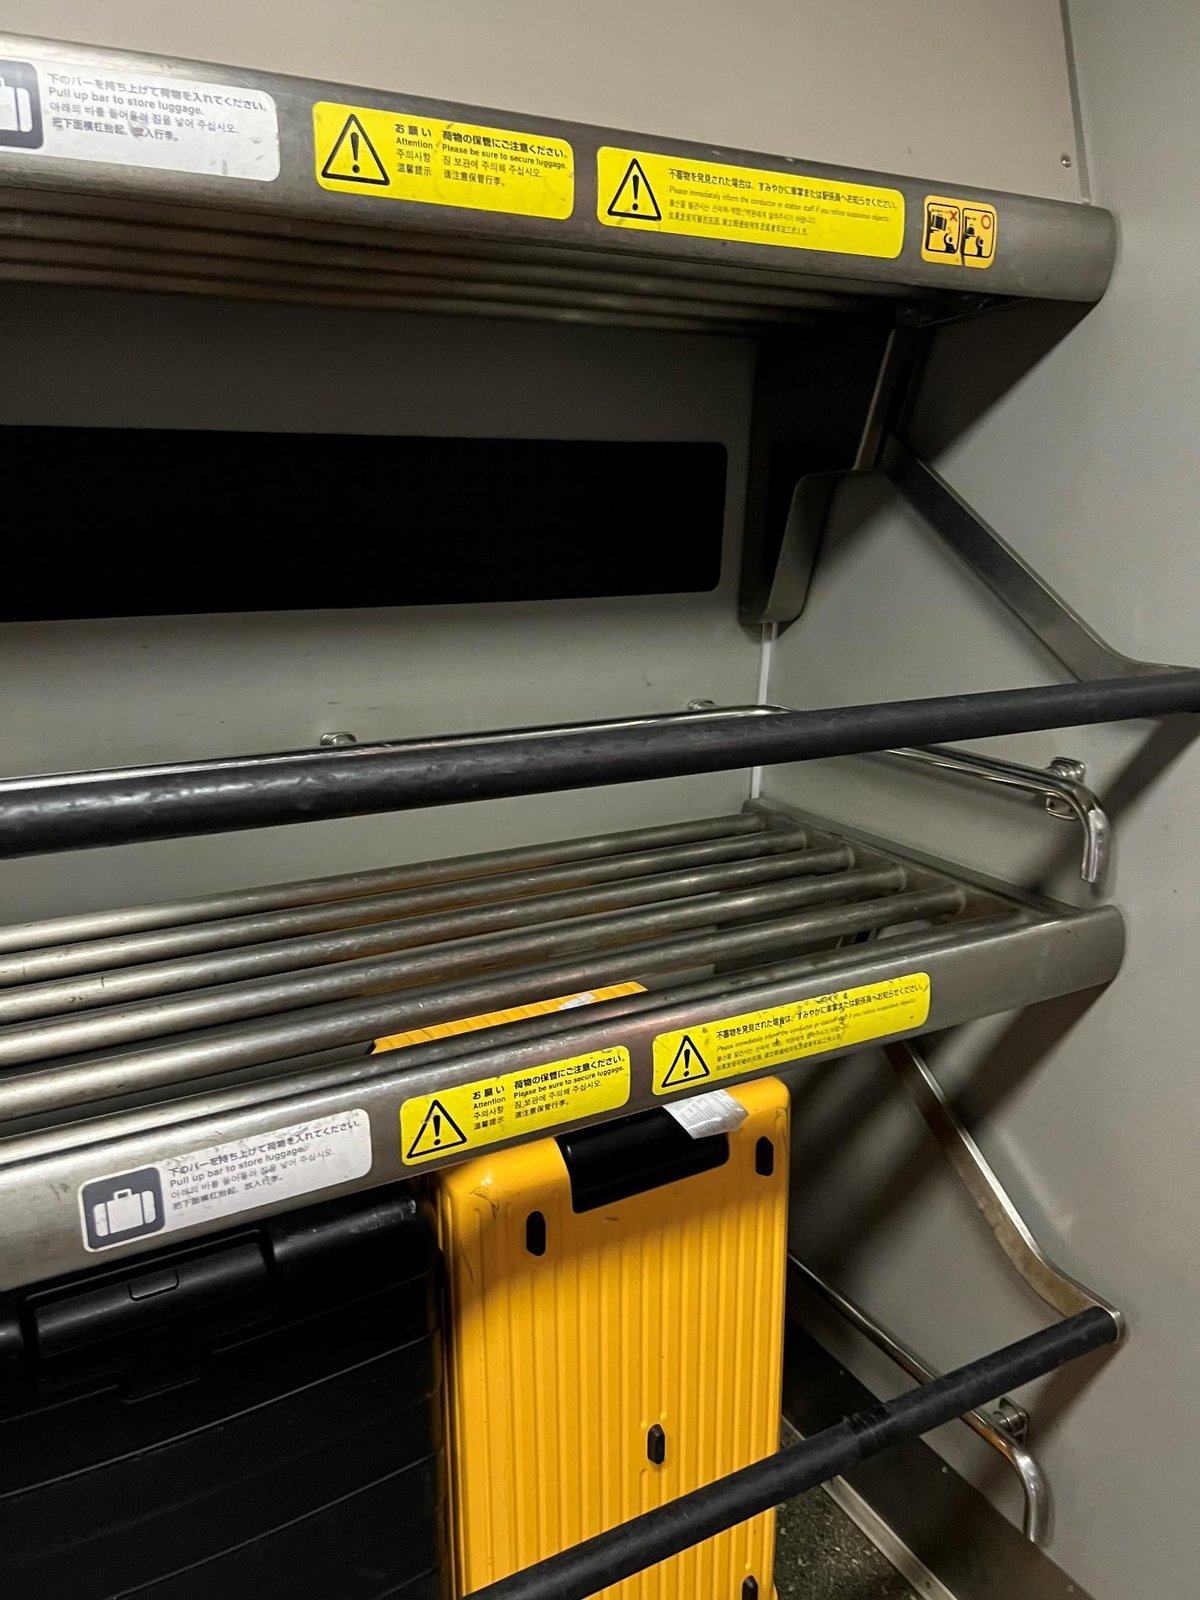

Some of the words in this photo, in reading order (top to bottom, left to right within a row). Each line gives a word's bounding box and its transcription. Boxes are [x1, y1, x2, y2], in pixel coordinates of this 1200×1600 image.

[49, 87, 71, 98] Pull
[74, 90, 88, 102] up
[92, 92, 109, 103] bar
[113, 95, 124, 105] to
[127, 97, 155, 109] store
[158, 100, 204, 115] luggage.
[396, 136, 433, 149] Attention
[442, 130, 568, 158] 荷物の保管にご注意ください。
[442, 143, 468, 155] Please
[470, 147, 480, 156] be
[482, 150, 498, 158] sure
[500, 151, 508, 160] to
[510, 154, 535, 164] secure
[513, 1086, 536, 1098] Please
[538, 1084, 547, 1093] be
[548, 1080, 563, 1090] sure
[565, 1077, 572, 1086] to
[573, 1072, 596, 1083] secure
[514, 1055, 625, 1090] 荷物の保管にご注意ください。
[472, 1085, 505, 1100] お願い
[473, 1096, 506, 1110] Attention
[170, 1175, 189, 1188] Pull
[192, 1172, 205, 1182] up
[207, 1168, 223, 1178] bar
[226, 1164, 236, 1173] to
[238, 1156, 263, 1168] store
